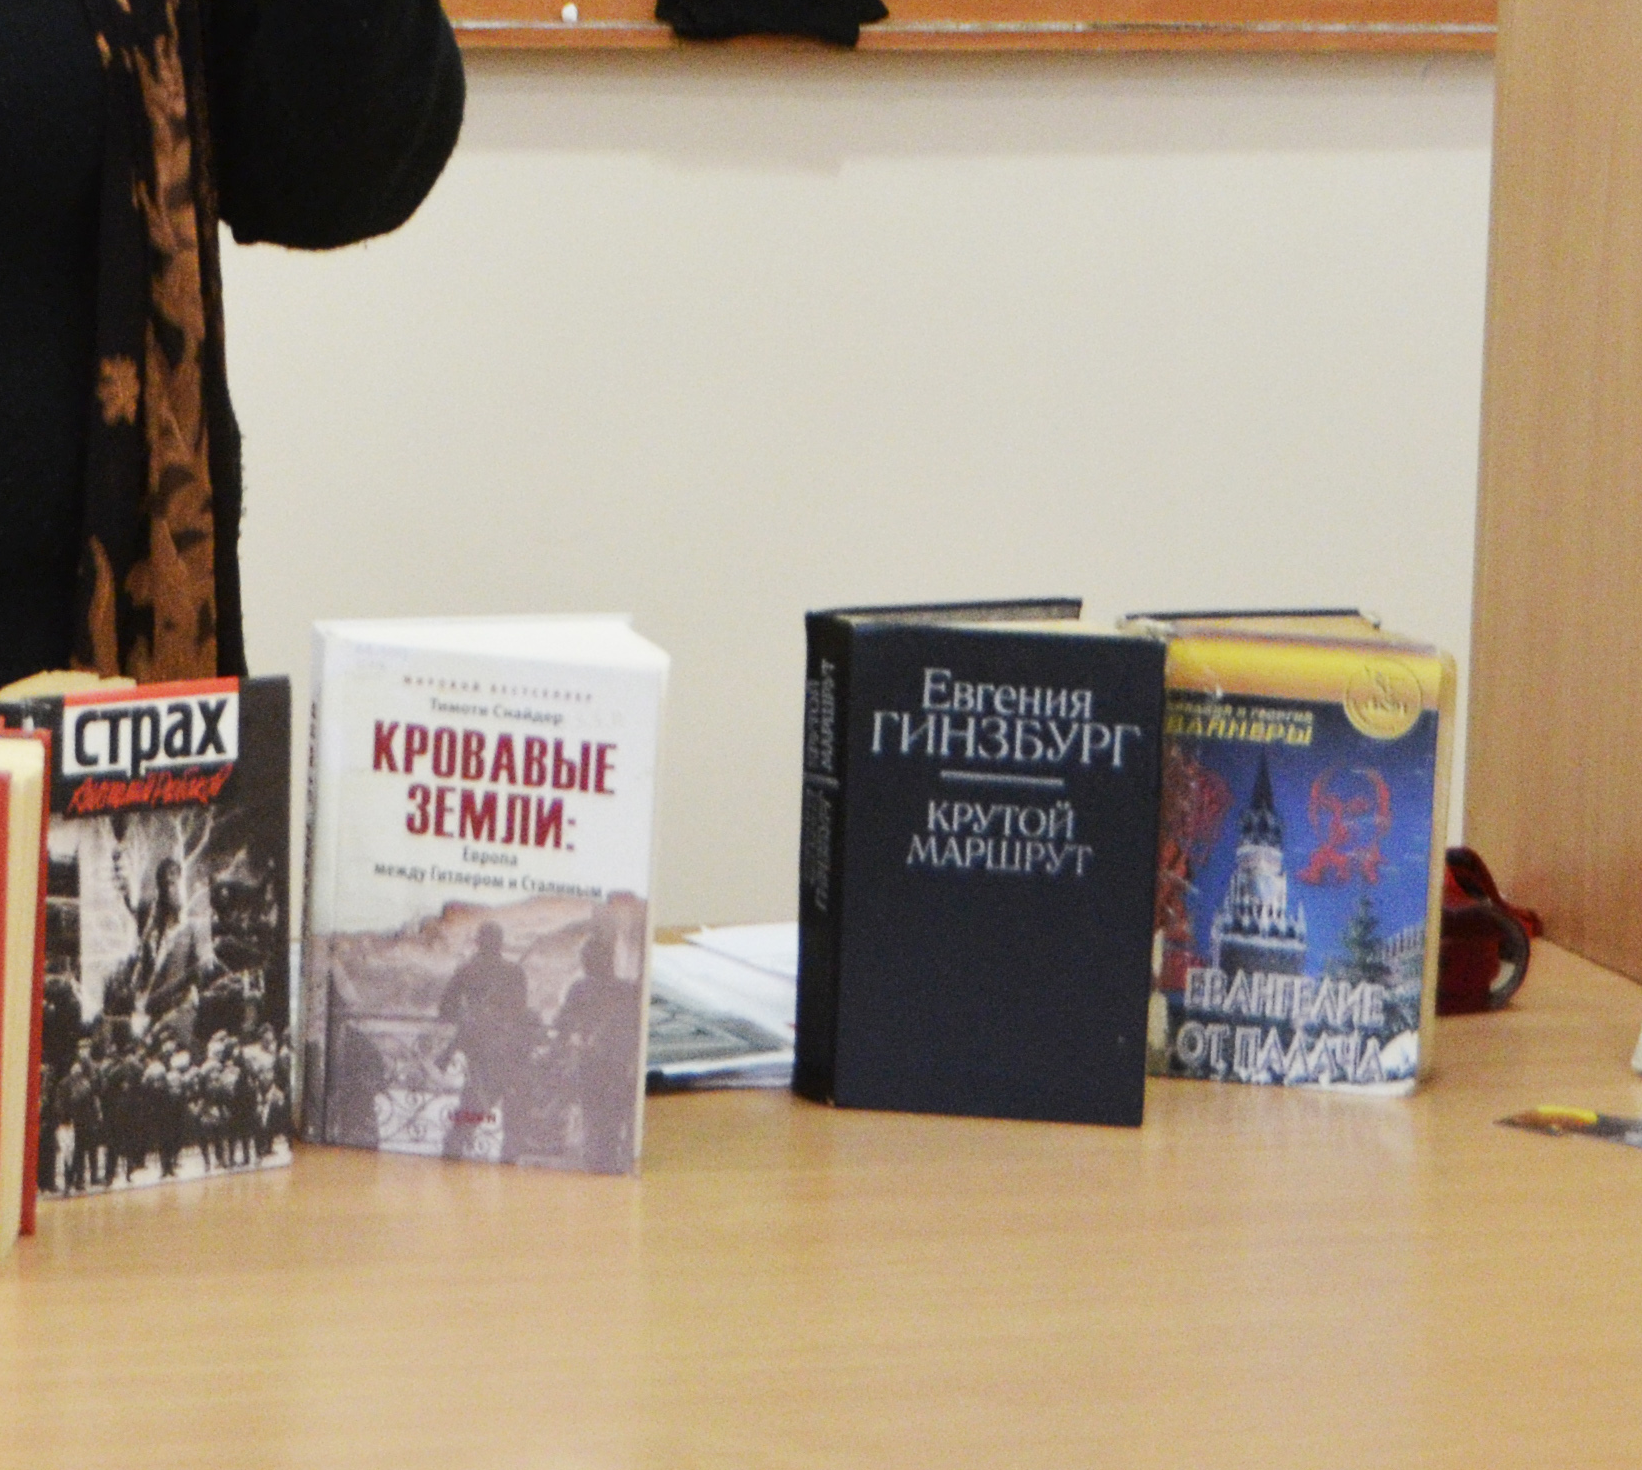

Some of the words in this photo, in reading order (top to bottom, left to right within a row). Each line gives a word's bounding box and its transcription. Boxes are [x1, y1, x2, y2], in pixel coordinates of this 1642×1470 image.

[430, 697, 488, 716] Тимоти
[493, 702, 563, 727] Снайдер
[921, 667, 1094, 720] Евгения
[372, 719, 617, 795] КРОВАВЫЕ
[871, 710, 1142, 768] ГИНЗБУРГ
[406, 784, 576, 851] ЗЕМЛИ:
[927, 800, 1075, 840] КРУТОЙ
[374, 862, 426, 883] между
[431, 866, 504, 890] Гитлером
[508, 877, 518, 889] и
[522, 875, 602, 898] Сталиным
[463, 845, 518, 867] Европа
[907, 833, 1094, 877] МАРШРУТ
[1183, 966, 1386, 1029] ЕВАНГЕЛИЕ
[1176, 1020, 1230, 1074] ОТ
[1233, 1024, 1388, 1085] ПАЛАЧА
